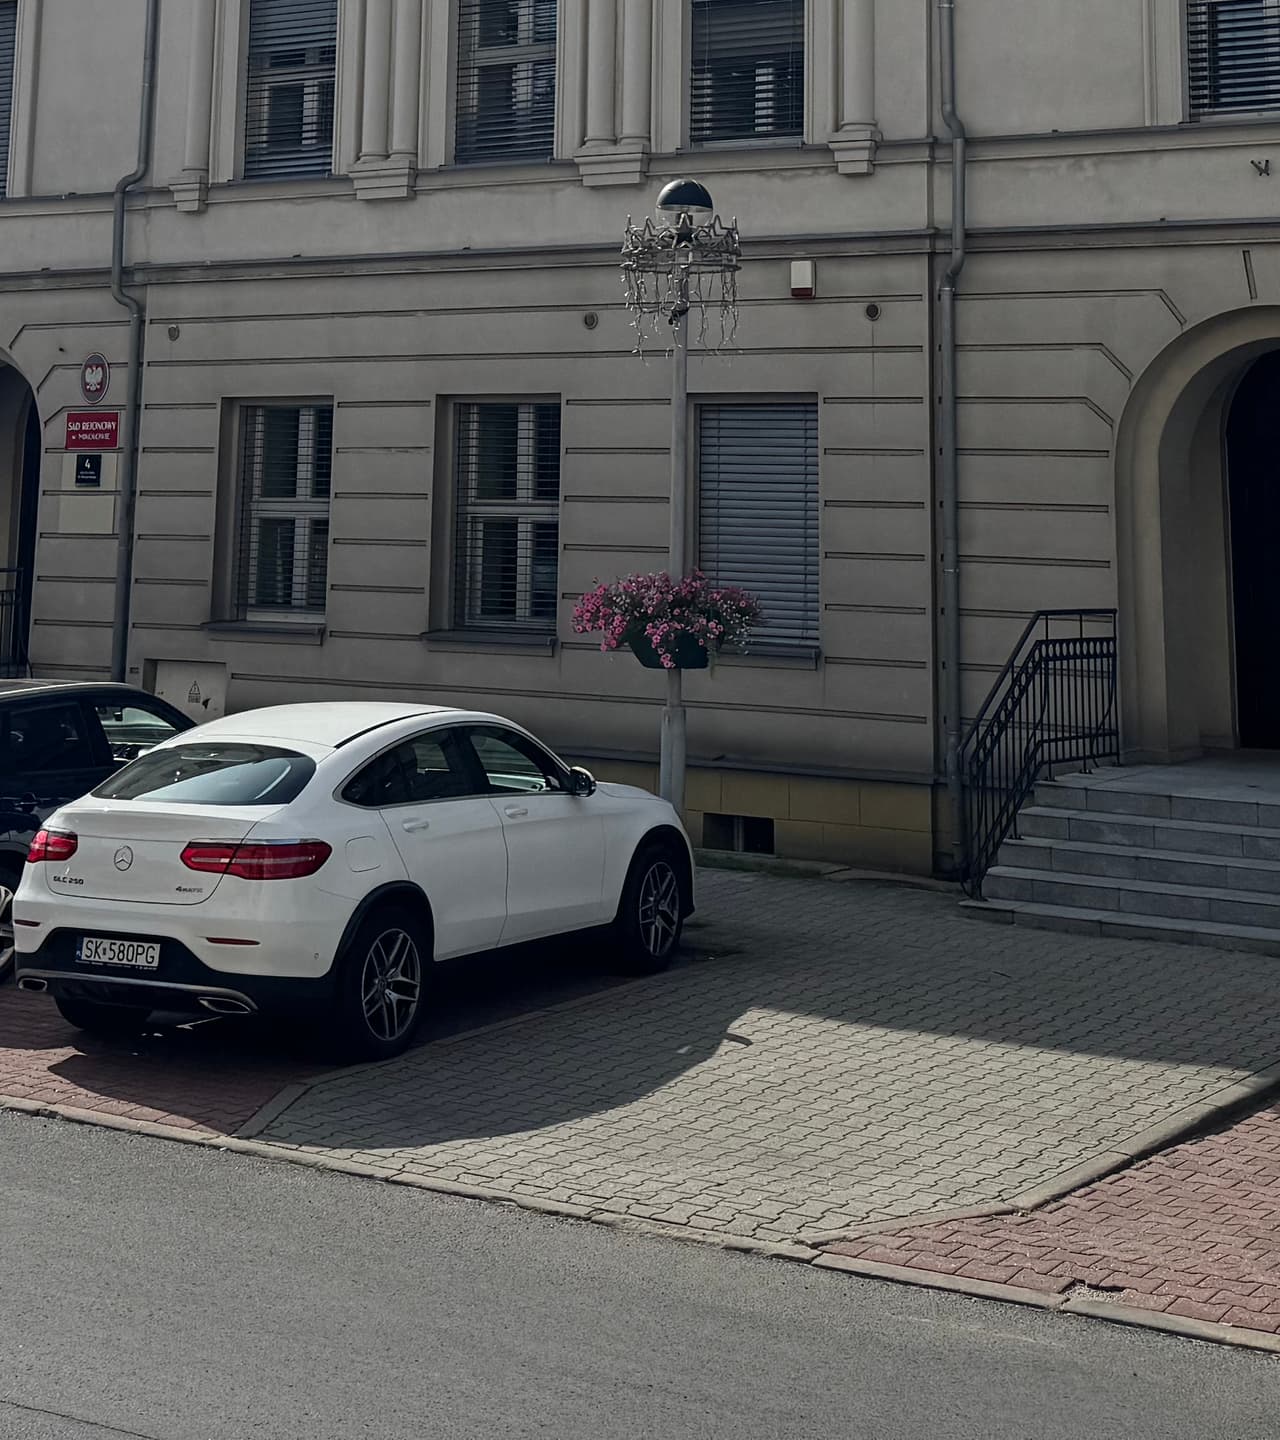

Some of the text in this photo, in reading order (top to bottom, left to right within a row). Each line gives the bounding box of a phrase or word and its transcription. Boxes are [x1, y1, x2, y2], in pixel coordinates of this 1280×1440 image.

[84, 458, 91, 470] 4
[84, 939, 103, 960] SK
[108, 941, 156, 965] 580PG
